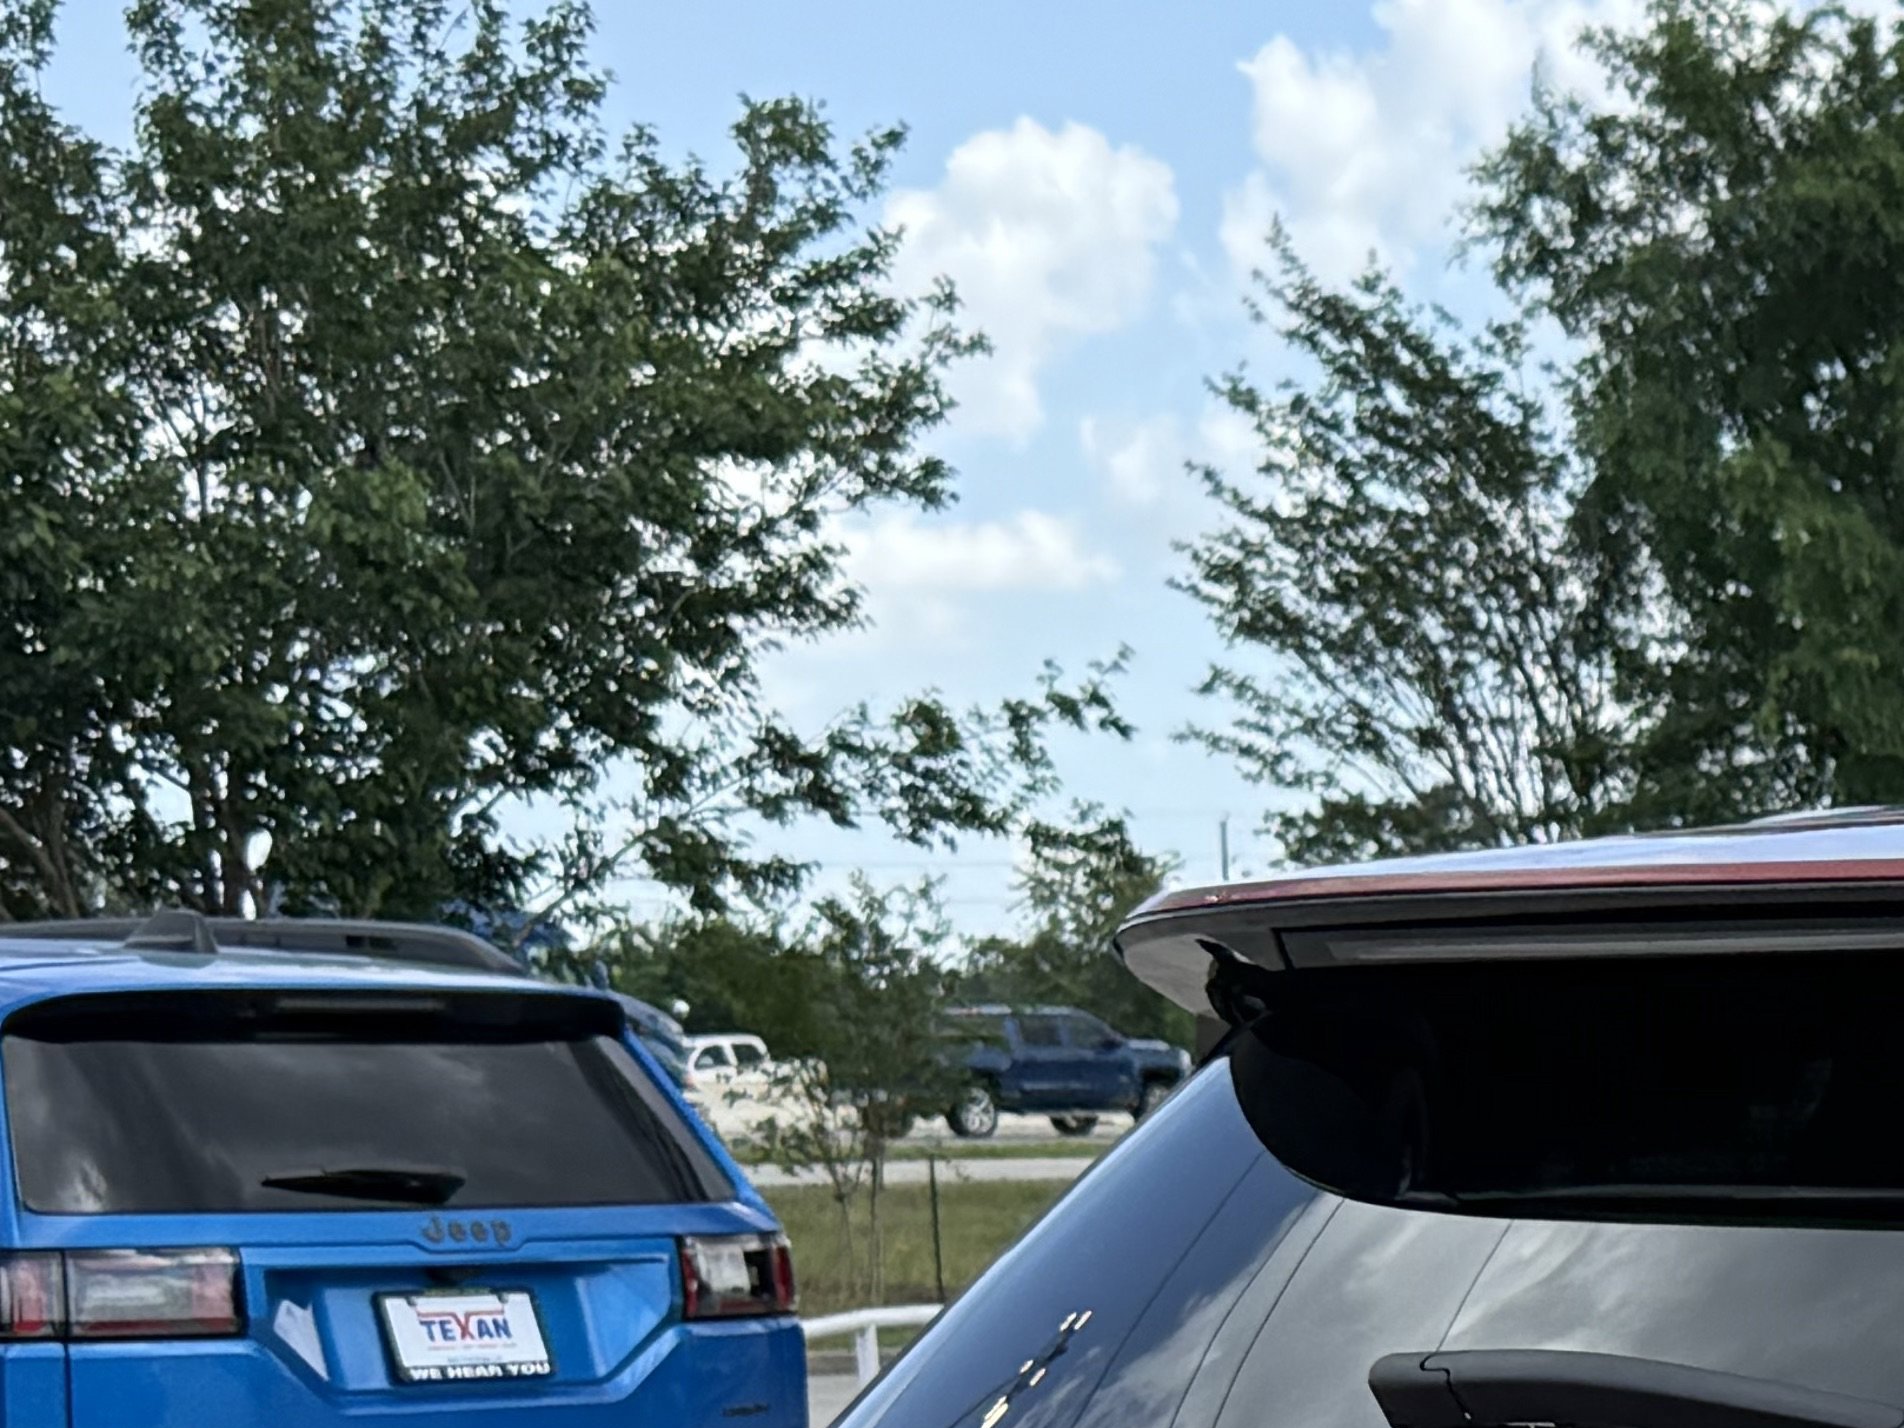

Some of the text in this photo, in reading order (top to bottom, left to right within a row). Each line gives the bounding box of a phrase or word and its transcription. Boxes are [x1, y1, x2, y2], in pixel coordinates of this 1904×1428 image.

[422, 1216, 512, 1247] Jeep
[419, 1312, 512, 1343] TEXAN
[410, 1361, 550, 1381] WE HEAR YOU
